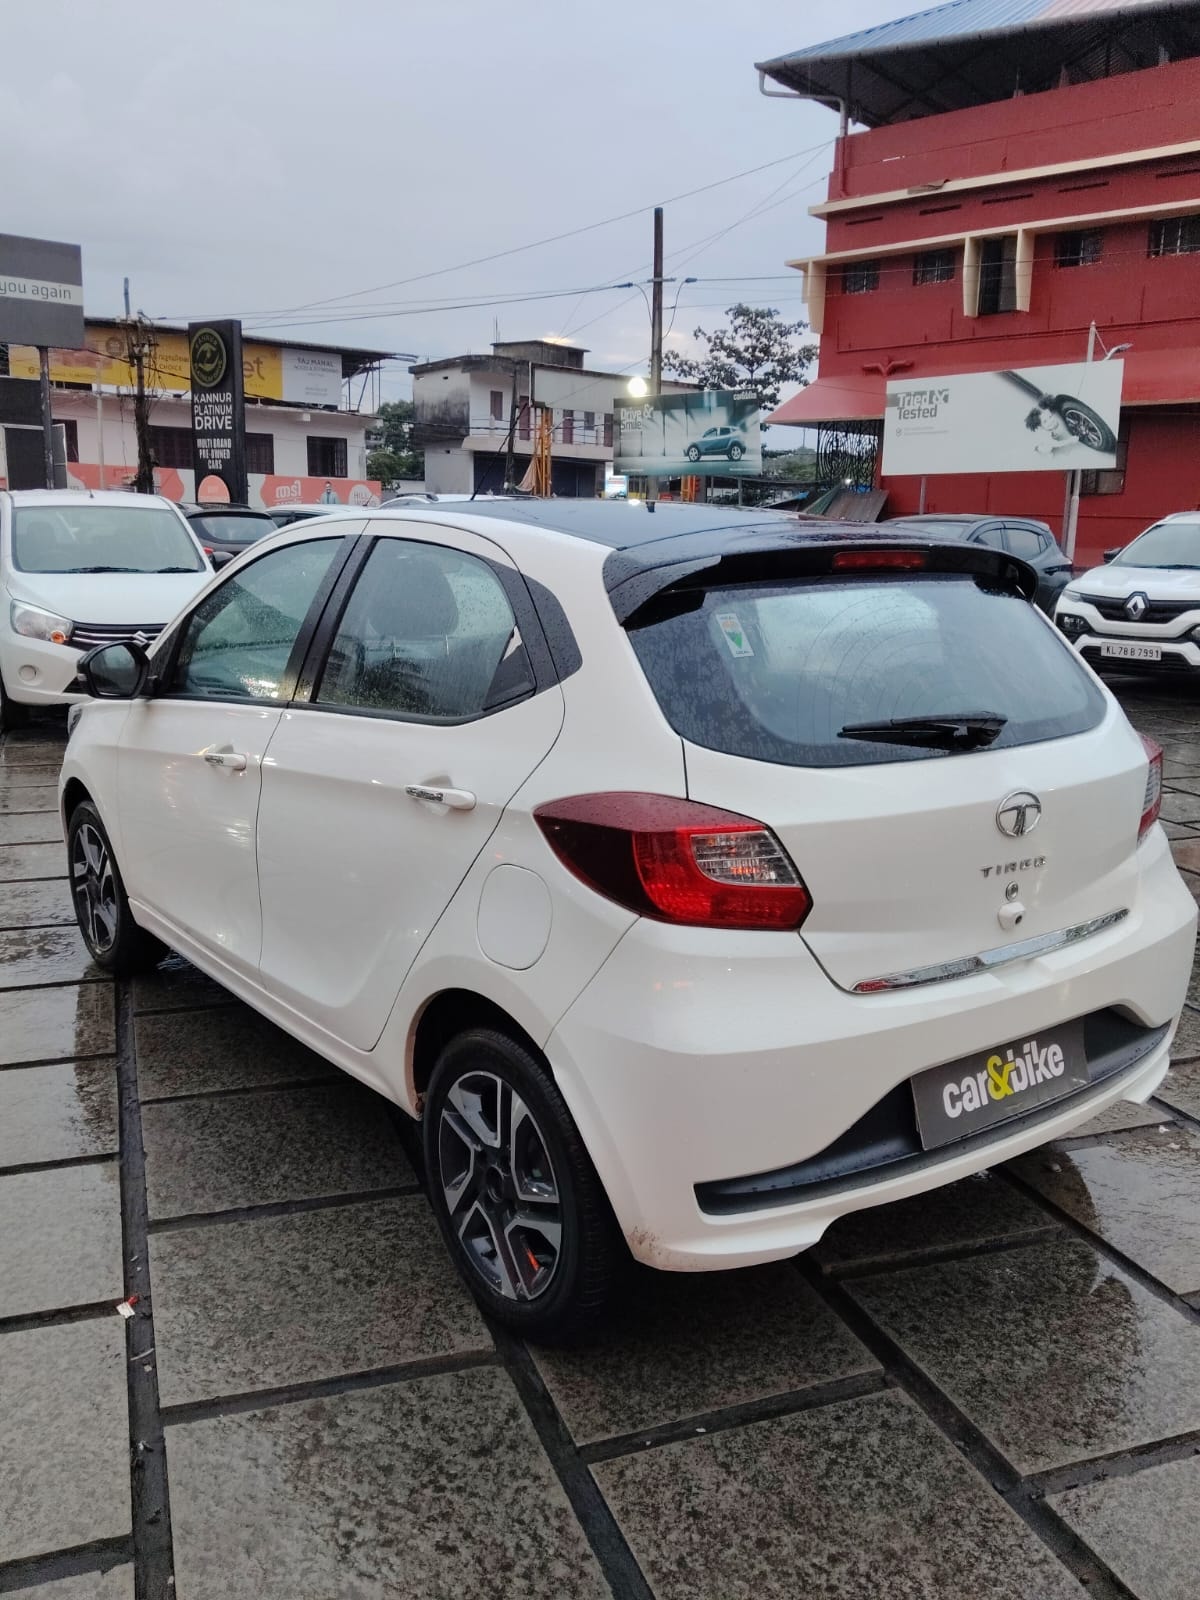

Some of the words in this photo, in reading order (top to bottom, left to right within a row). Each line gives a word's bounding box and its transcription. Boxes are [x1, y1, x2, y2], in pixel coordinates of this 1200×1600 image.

[0, 281, 26, 295] you
[31, 284, 71, 300] again
[193, 392, 232, 404] KANNUR
[897, 390, 928, 407] Tried
[932, 388, 949, 405] &
[194, 404, 233, 416] PLATINUM
[620, 406, 642, 420] Drive
[643, 403, 654, 418] &
[897, 404, 938, 420] Tested
[194, 415, 233, 430] DRIVE
[620, 419, 642, 431] Smile
[196, 438, 213, 449] MULTI
[213, 438, 232, 449] BRAND
[199, 449, 231, 459] PRE-OWNED
[207, 459, 223, 470] CARS
[1106, 646, 1116, 655] KL
[942, 1040, 1065, 1119] car&bike
